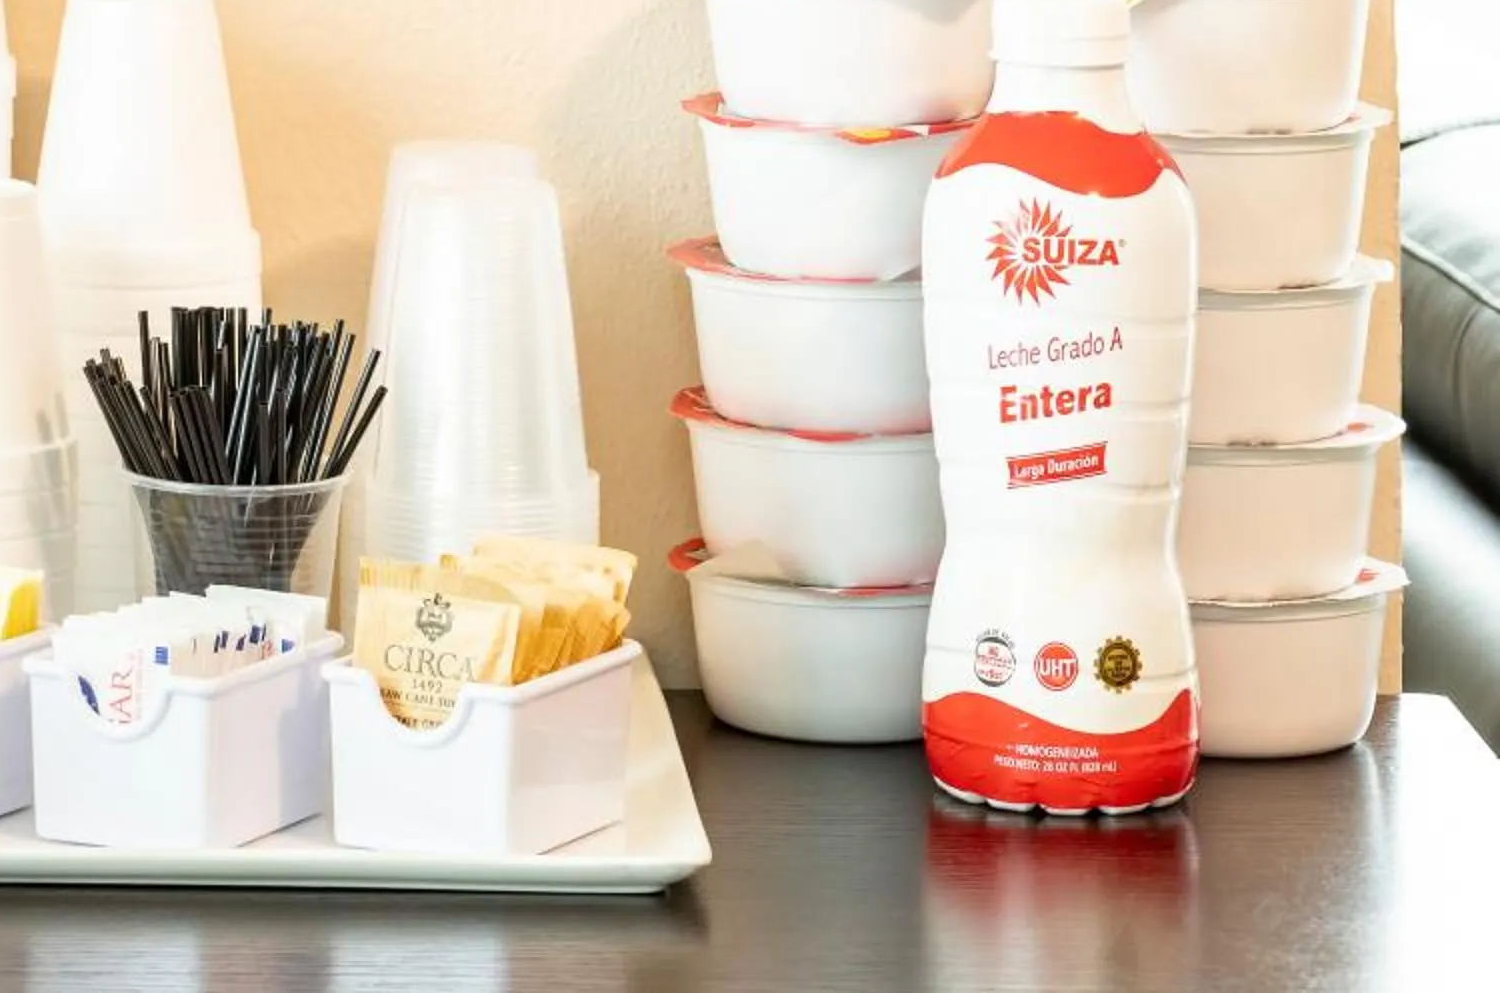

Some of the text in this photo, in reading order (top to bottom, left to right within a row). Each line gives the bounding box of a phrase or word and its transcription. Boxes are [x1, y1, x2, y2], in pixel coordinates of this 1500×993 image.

[1021, 237, 1120, 266] SUIZA
[987, 326, 1123, 370] Leche Grado A
[999, 381, 1113, 424] Entera
[1014, 463, 1045, 480] Larga
[384, 644, 476, 683] CIRCA
[1038, 657, 1077, 675] UHT
[412, 678, 443, 694] 1492
